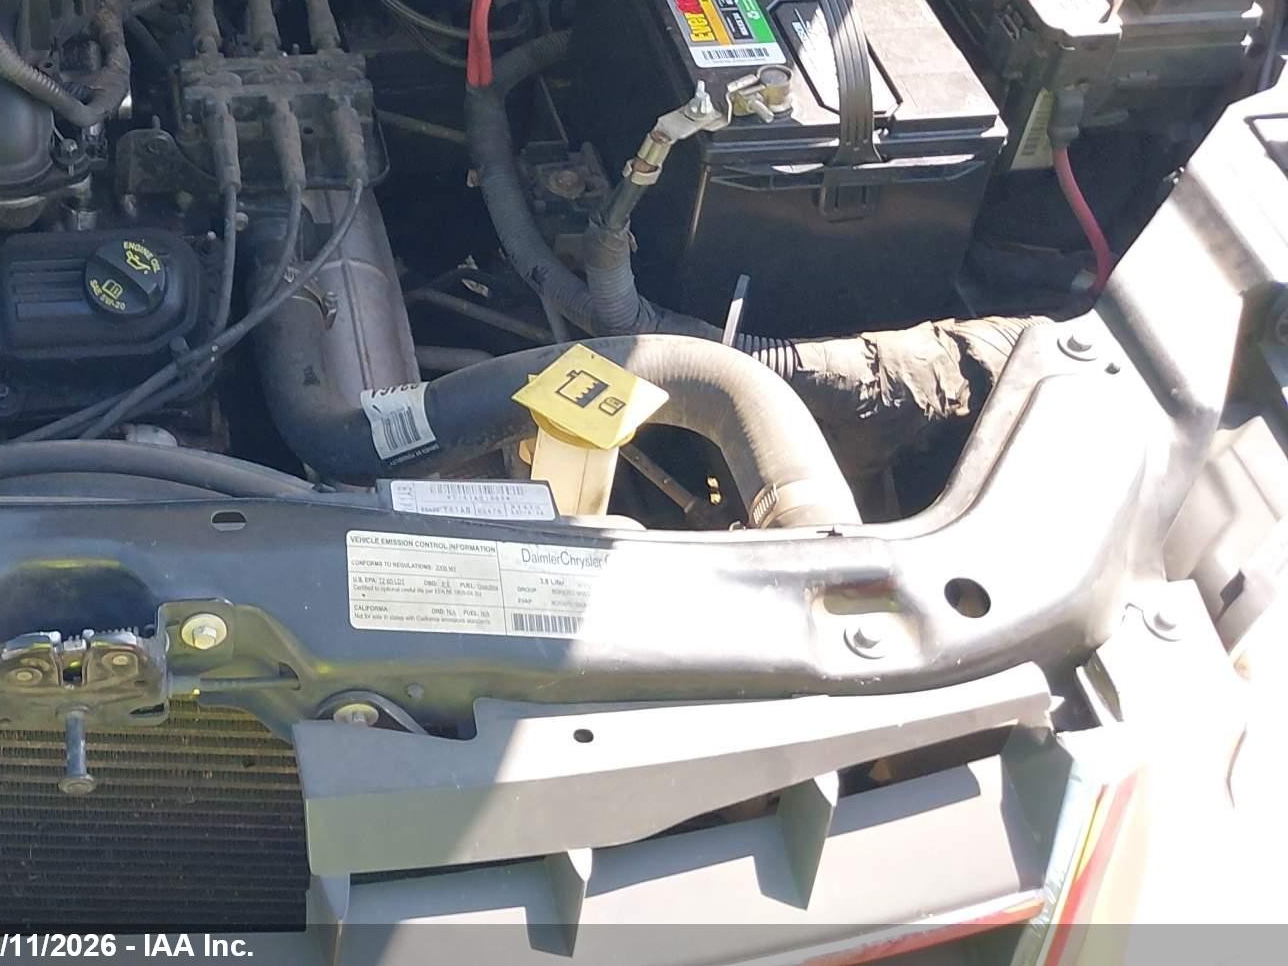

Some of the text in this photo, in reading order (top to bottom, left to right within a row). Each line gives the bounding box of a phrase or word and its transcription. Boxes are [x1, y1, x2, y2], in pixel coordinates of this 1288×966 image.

[123, 241, 160, 273] ENGINE OIL
[350, 536, 496, 554] VEHICLE EMISSION CONTROL INFORMATION
[521, 547, 603, 569] DaimlerChrysler
